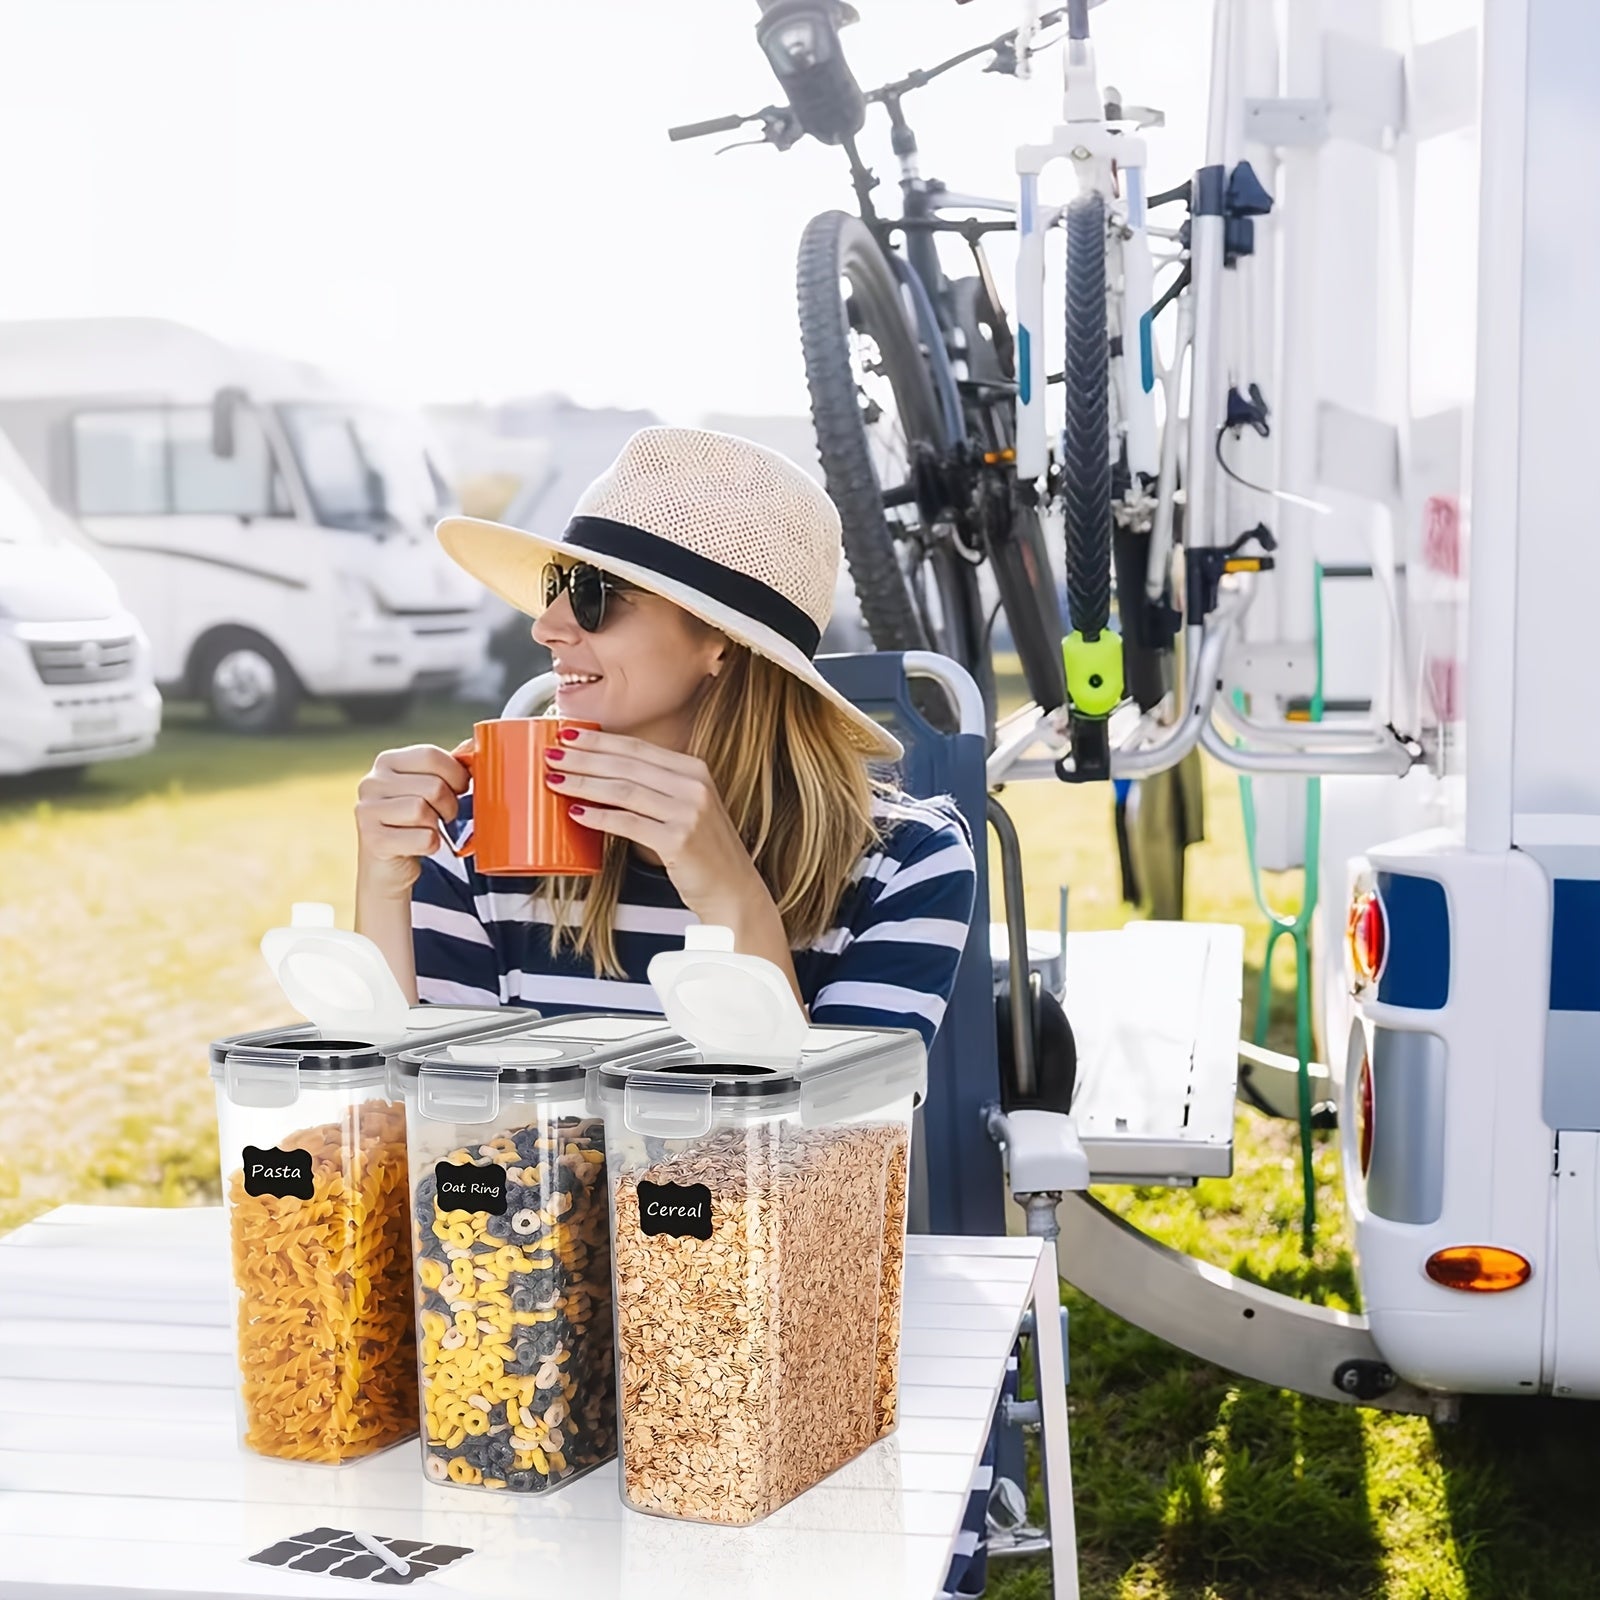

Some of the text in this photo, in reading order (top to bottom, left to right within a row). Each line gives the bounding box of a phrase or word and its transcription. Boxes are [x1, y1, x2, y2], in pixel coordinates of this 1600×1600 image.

[251, 1164, 301, 1179] Pasta
[441, 1181, 500, 1198] Oat Ring
[646, 1201, 702, 1218] Cereal
